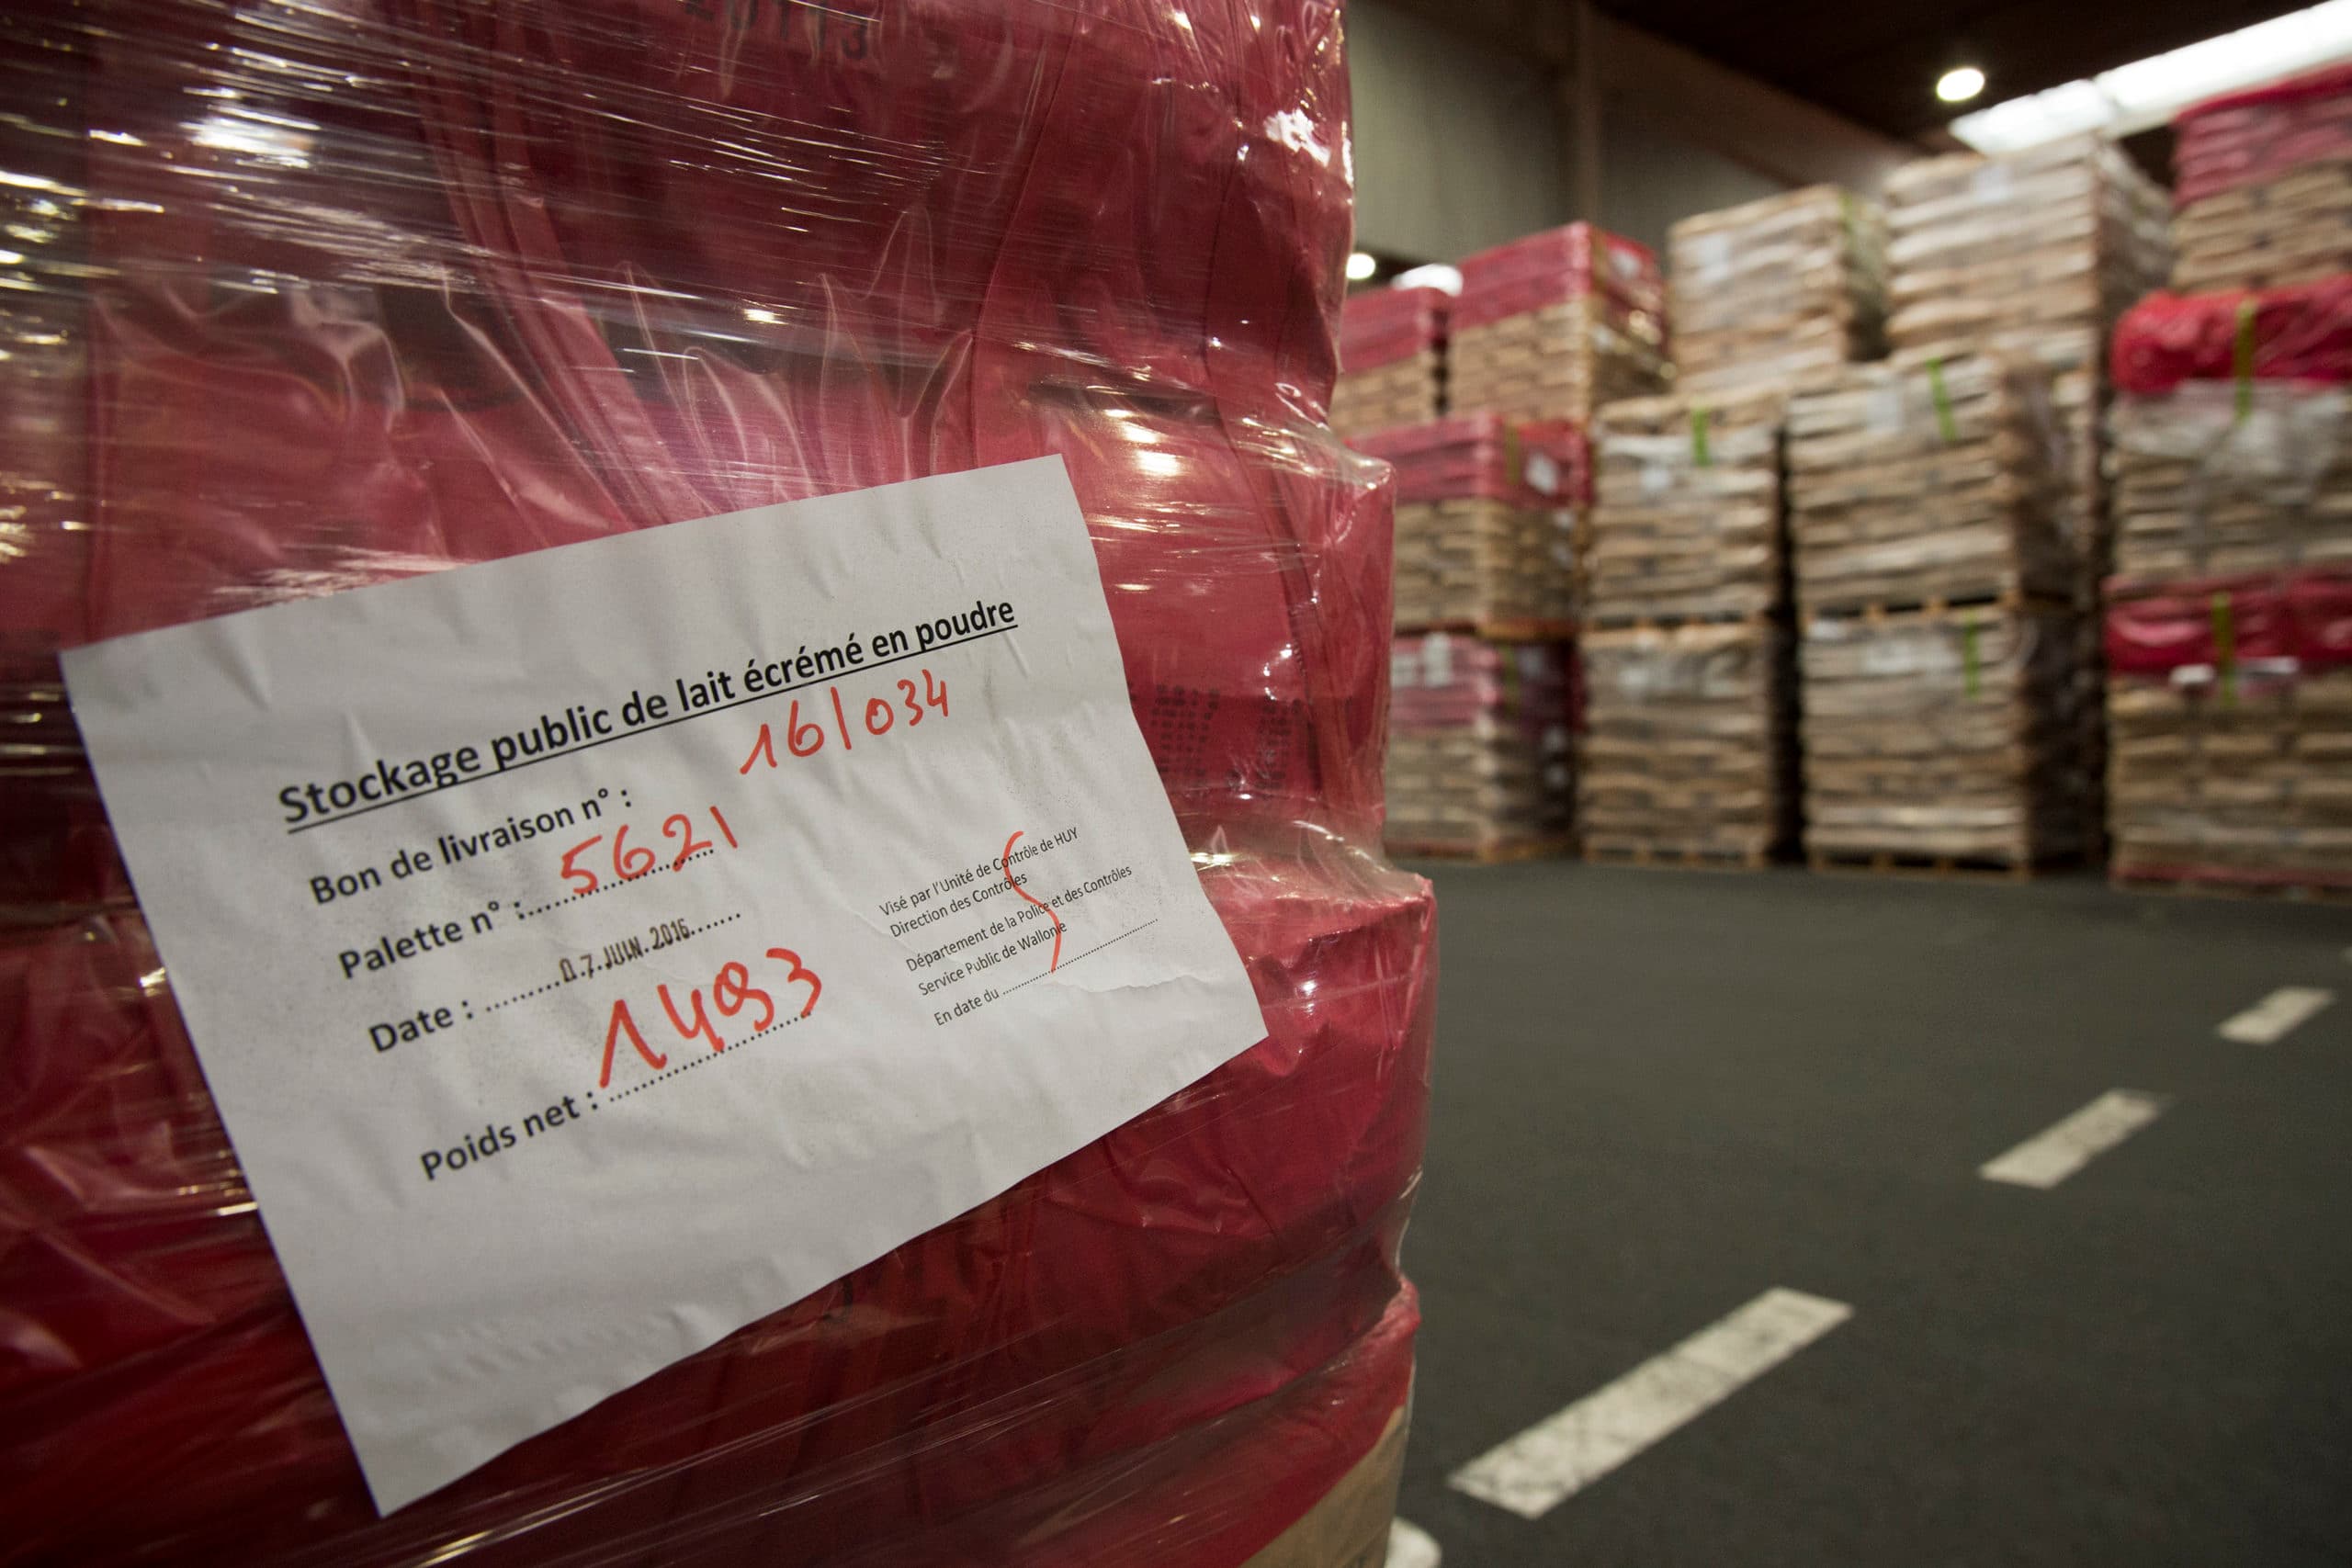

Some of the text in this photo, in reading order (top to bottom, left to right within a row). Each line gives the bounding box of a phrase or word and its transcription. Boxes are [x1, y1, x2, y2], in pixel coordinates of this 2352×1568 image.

[278, 601, 1015, 823] Stockage public de lait écrémé en poudre
[310, 866, 381, 905] Bon
[390, 850, 434, 879] de
[437, 805, 574, 865] livraison
[560, 806, 738, 895] 5621
[879, 894, 906, 917] Visé
[910, 886, 932, 908] par
[976, 863, 991, 879] de
[992, 845, 1039, 871] Contrôle
[1040, 838, 1054, 852] de
[1054, 827, 1079, 846] HUY
[650, 918, 690, 951] 2016
[889, 873, 1027, 938] Direction des Contrôles
[906, 865, 1133, 972] Département de la Police et des Contrôles
[338, 919, 463, 978] Palette
[918, 921, 1068, 996] Service Public de Wallonie
[369, 1008, 454, 1054] Date
[599, 948, 822, 1089] 1493
[934, 987, 1001, 1026] En date du
[420, 1123, 517, 1180] Poids
[523, 1095, 581, 1138] net
